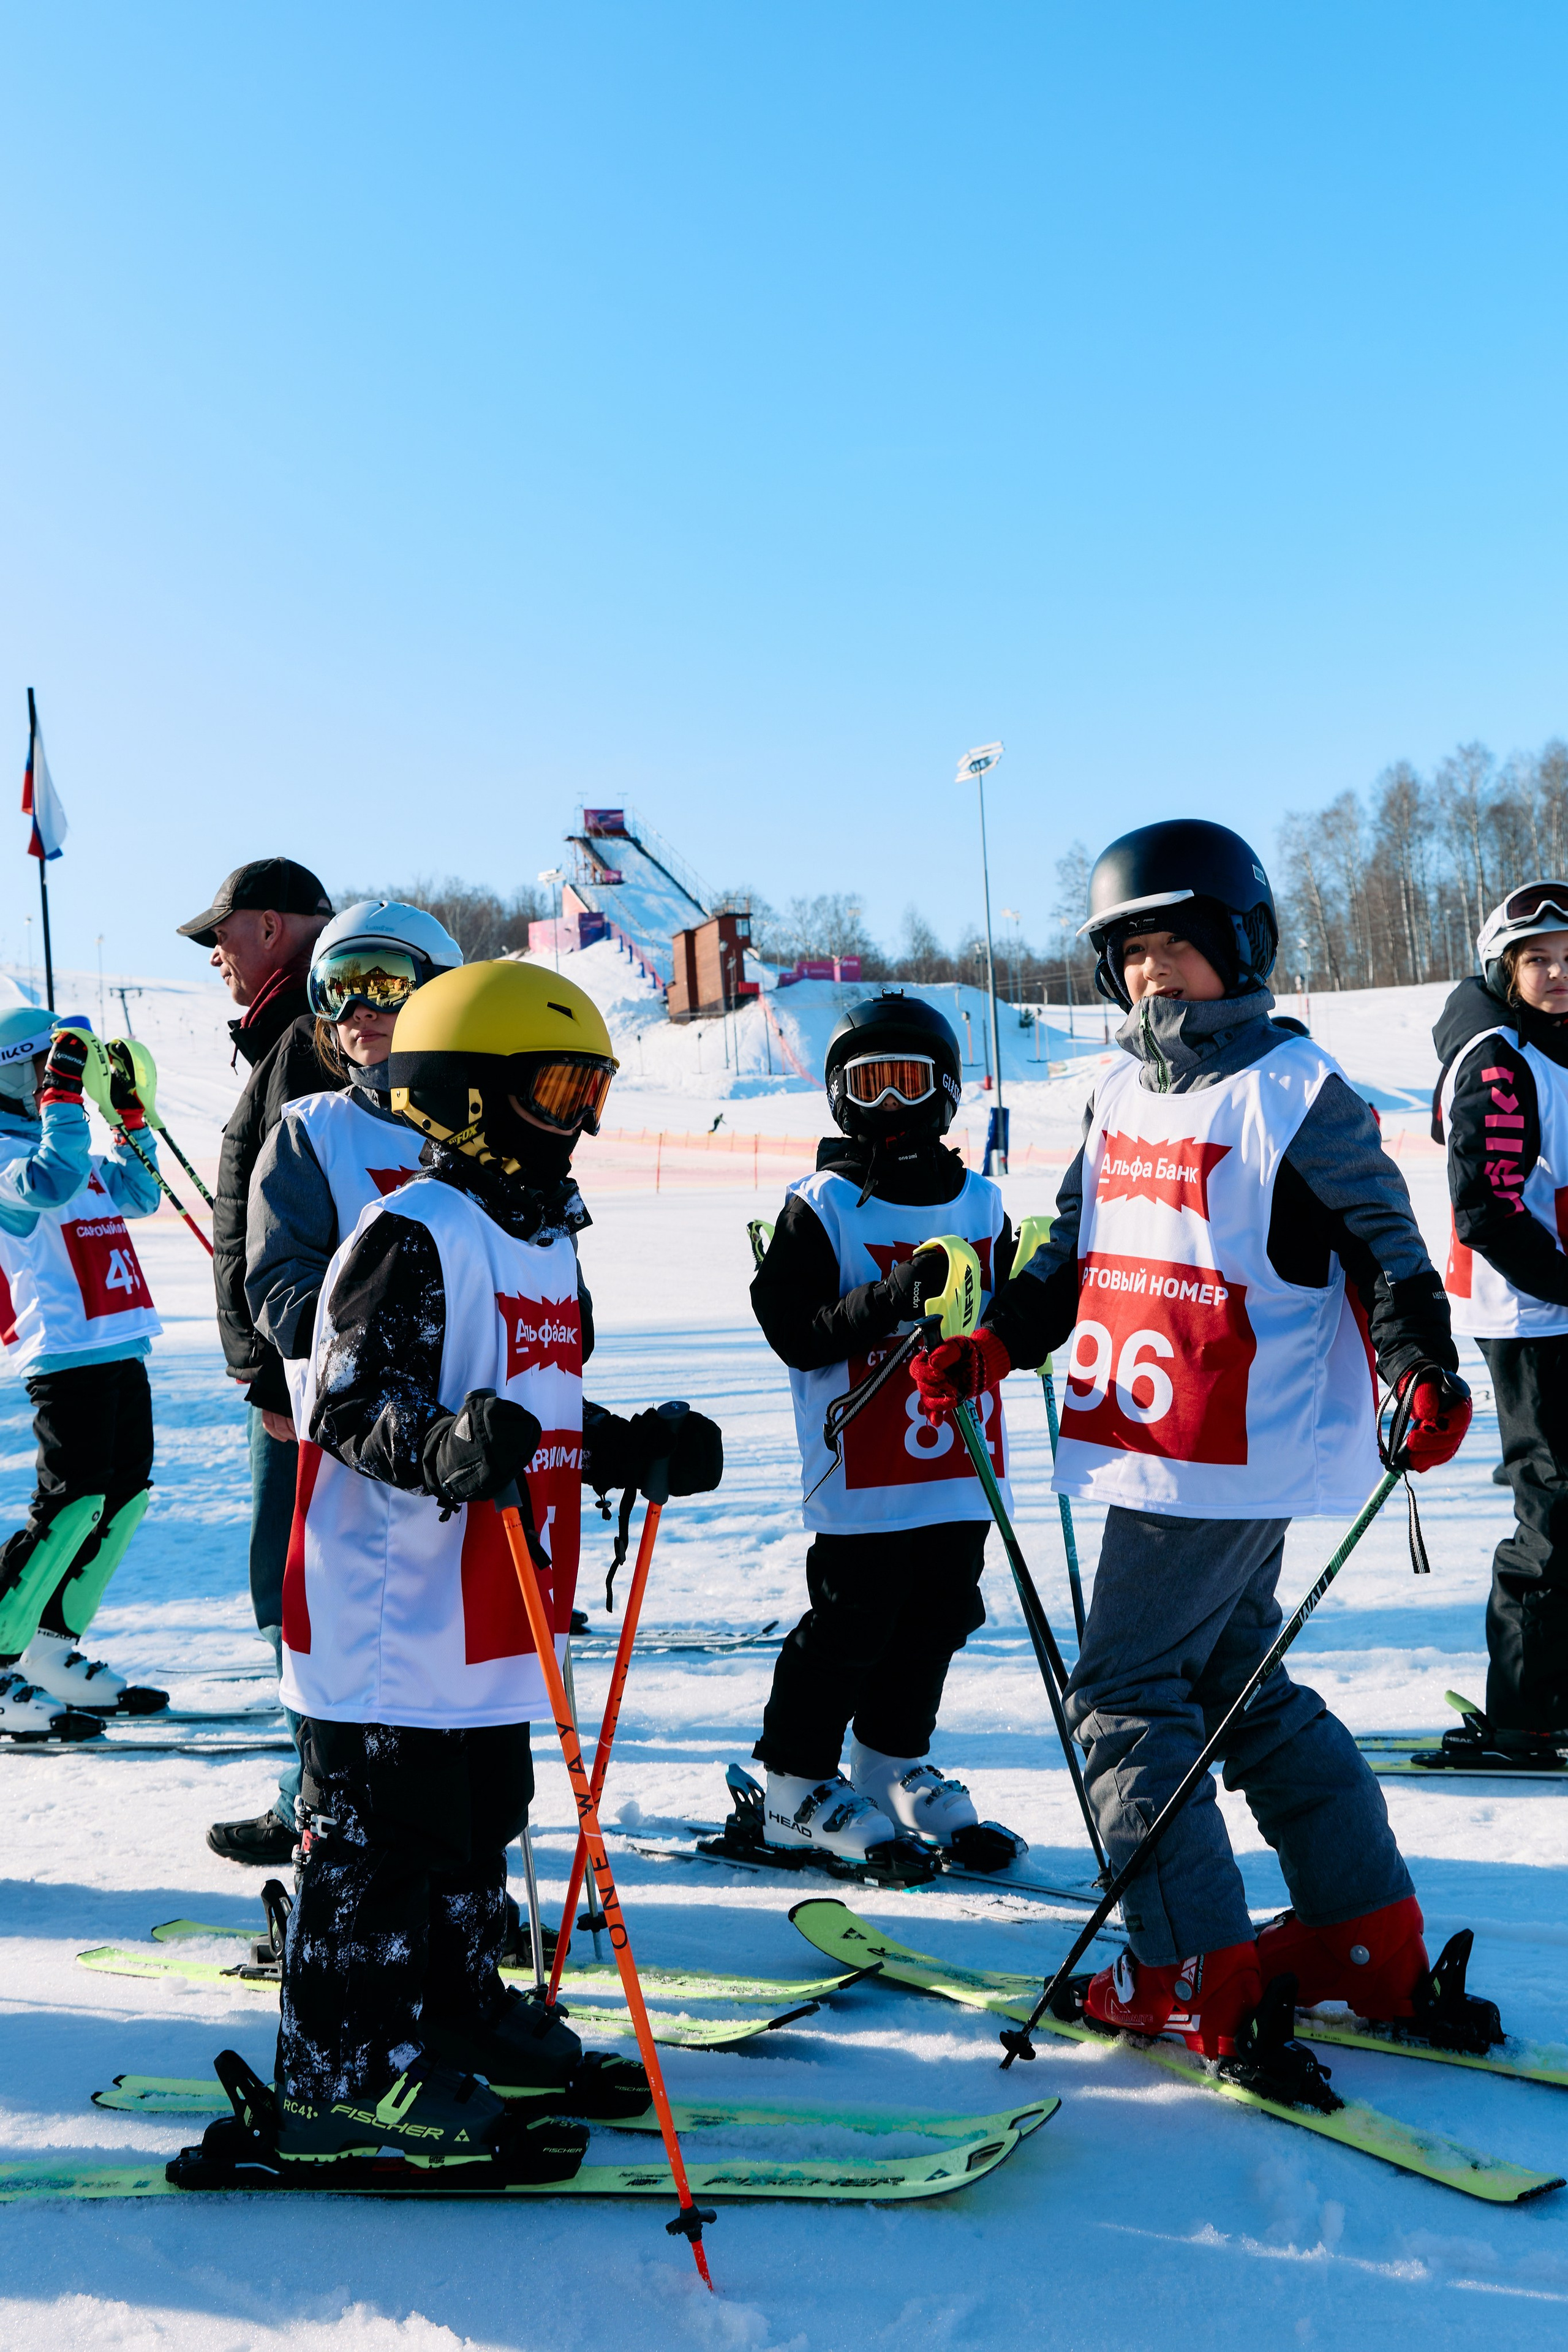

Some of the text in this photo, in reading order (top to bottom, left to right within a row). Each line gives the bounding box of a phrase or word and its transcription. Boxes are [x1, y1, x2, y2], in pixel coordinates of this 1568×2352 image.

[91, 1039, 108, 1077] LEKI
[447, 1122, 479, 1146] FOX
[144, 1161, 173, 1197] LEKI
[1099, 1153, 1199, 1183] Альфа Банк
[962, 1274, 974, 1328] UFO
[1149, 1275, 1229, 1306] НОМЕР
[1064, 1319, 1175, 1424] 96
[1354, 1479, 1396, 1538] masters
[37, 1629, 72, 1642] HEAD
[556, 1721, 594, 1819] WAY
[769, 1809, 812, 1839] HEAD
[589, 1849, 628, 1950] ONE
[1111, 2012, 1154, 2022] DOLOMITE
[284, 2098, 306, 2116] RC4
[330, 2104, 445, 2140] FISCHER
